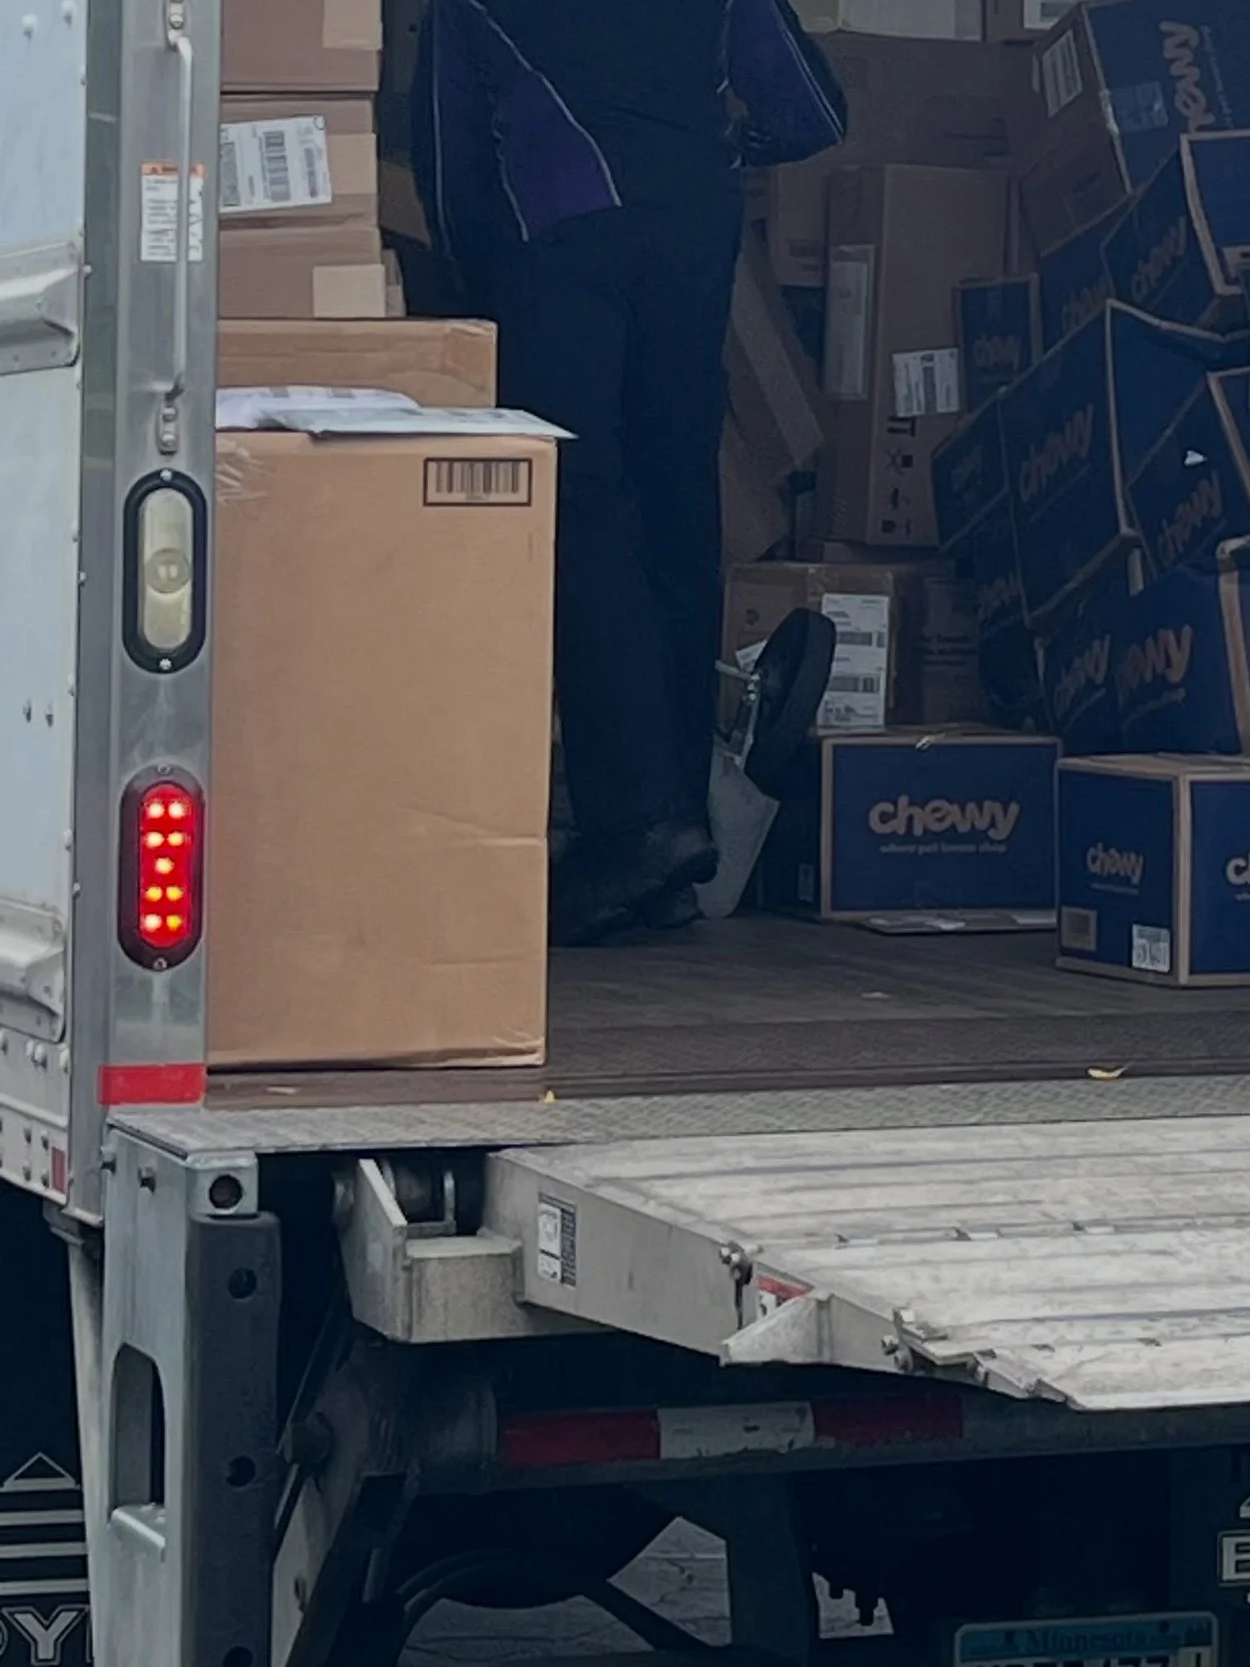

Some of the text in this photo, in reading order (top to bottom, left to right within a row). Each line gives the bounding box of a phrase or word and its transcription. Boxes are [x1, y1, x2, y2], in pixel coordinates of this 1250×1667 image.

[1159, 21, 1215, 132] hewy
[868, 794, 1020, 839] chewy
[1086, 841, 1145, 886] chewy
